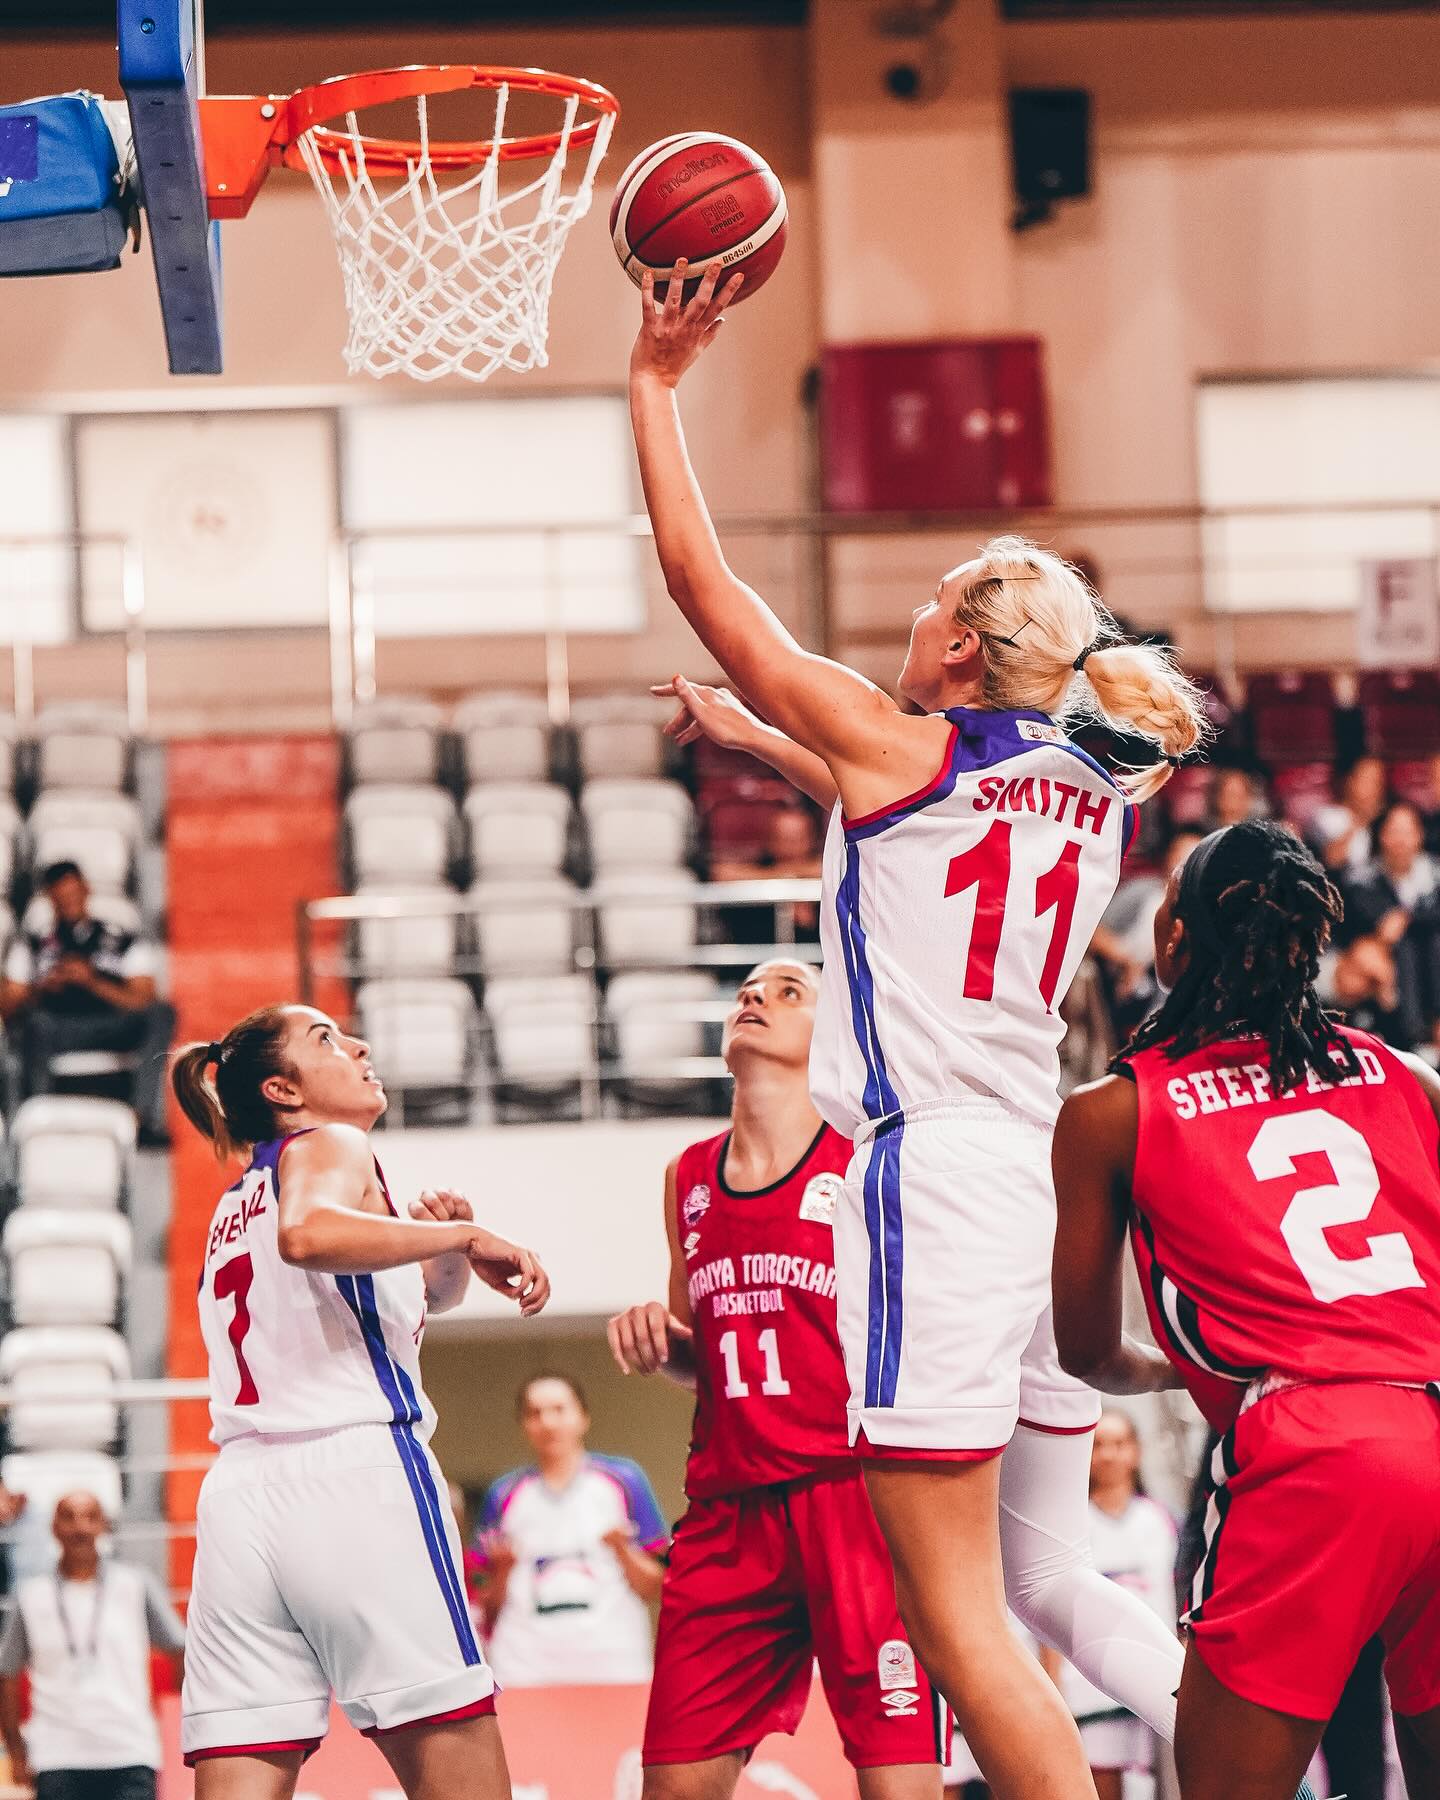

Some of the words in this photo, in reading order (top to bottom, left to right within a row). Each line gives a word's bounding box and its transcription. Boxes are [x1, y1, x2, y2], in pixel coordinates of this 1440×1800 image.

[701, 194, 740, 225] FIBA
[710, 211, 745, 235] APPROVED
[722, 242, 754, 264] BG4500
[972, 776, 1112, 836] SMITH
[944, 818, 1083, 1015] 11
[1167, 1048, 1386, 1120] SHEPARD
[1246, 1108, 1427, 1304] 2
[214, 1251, 260, 1406] 7
[712, 1288, 785, 1318] BASKETBOL
[719, 1328, 791, 1399] 11
